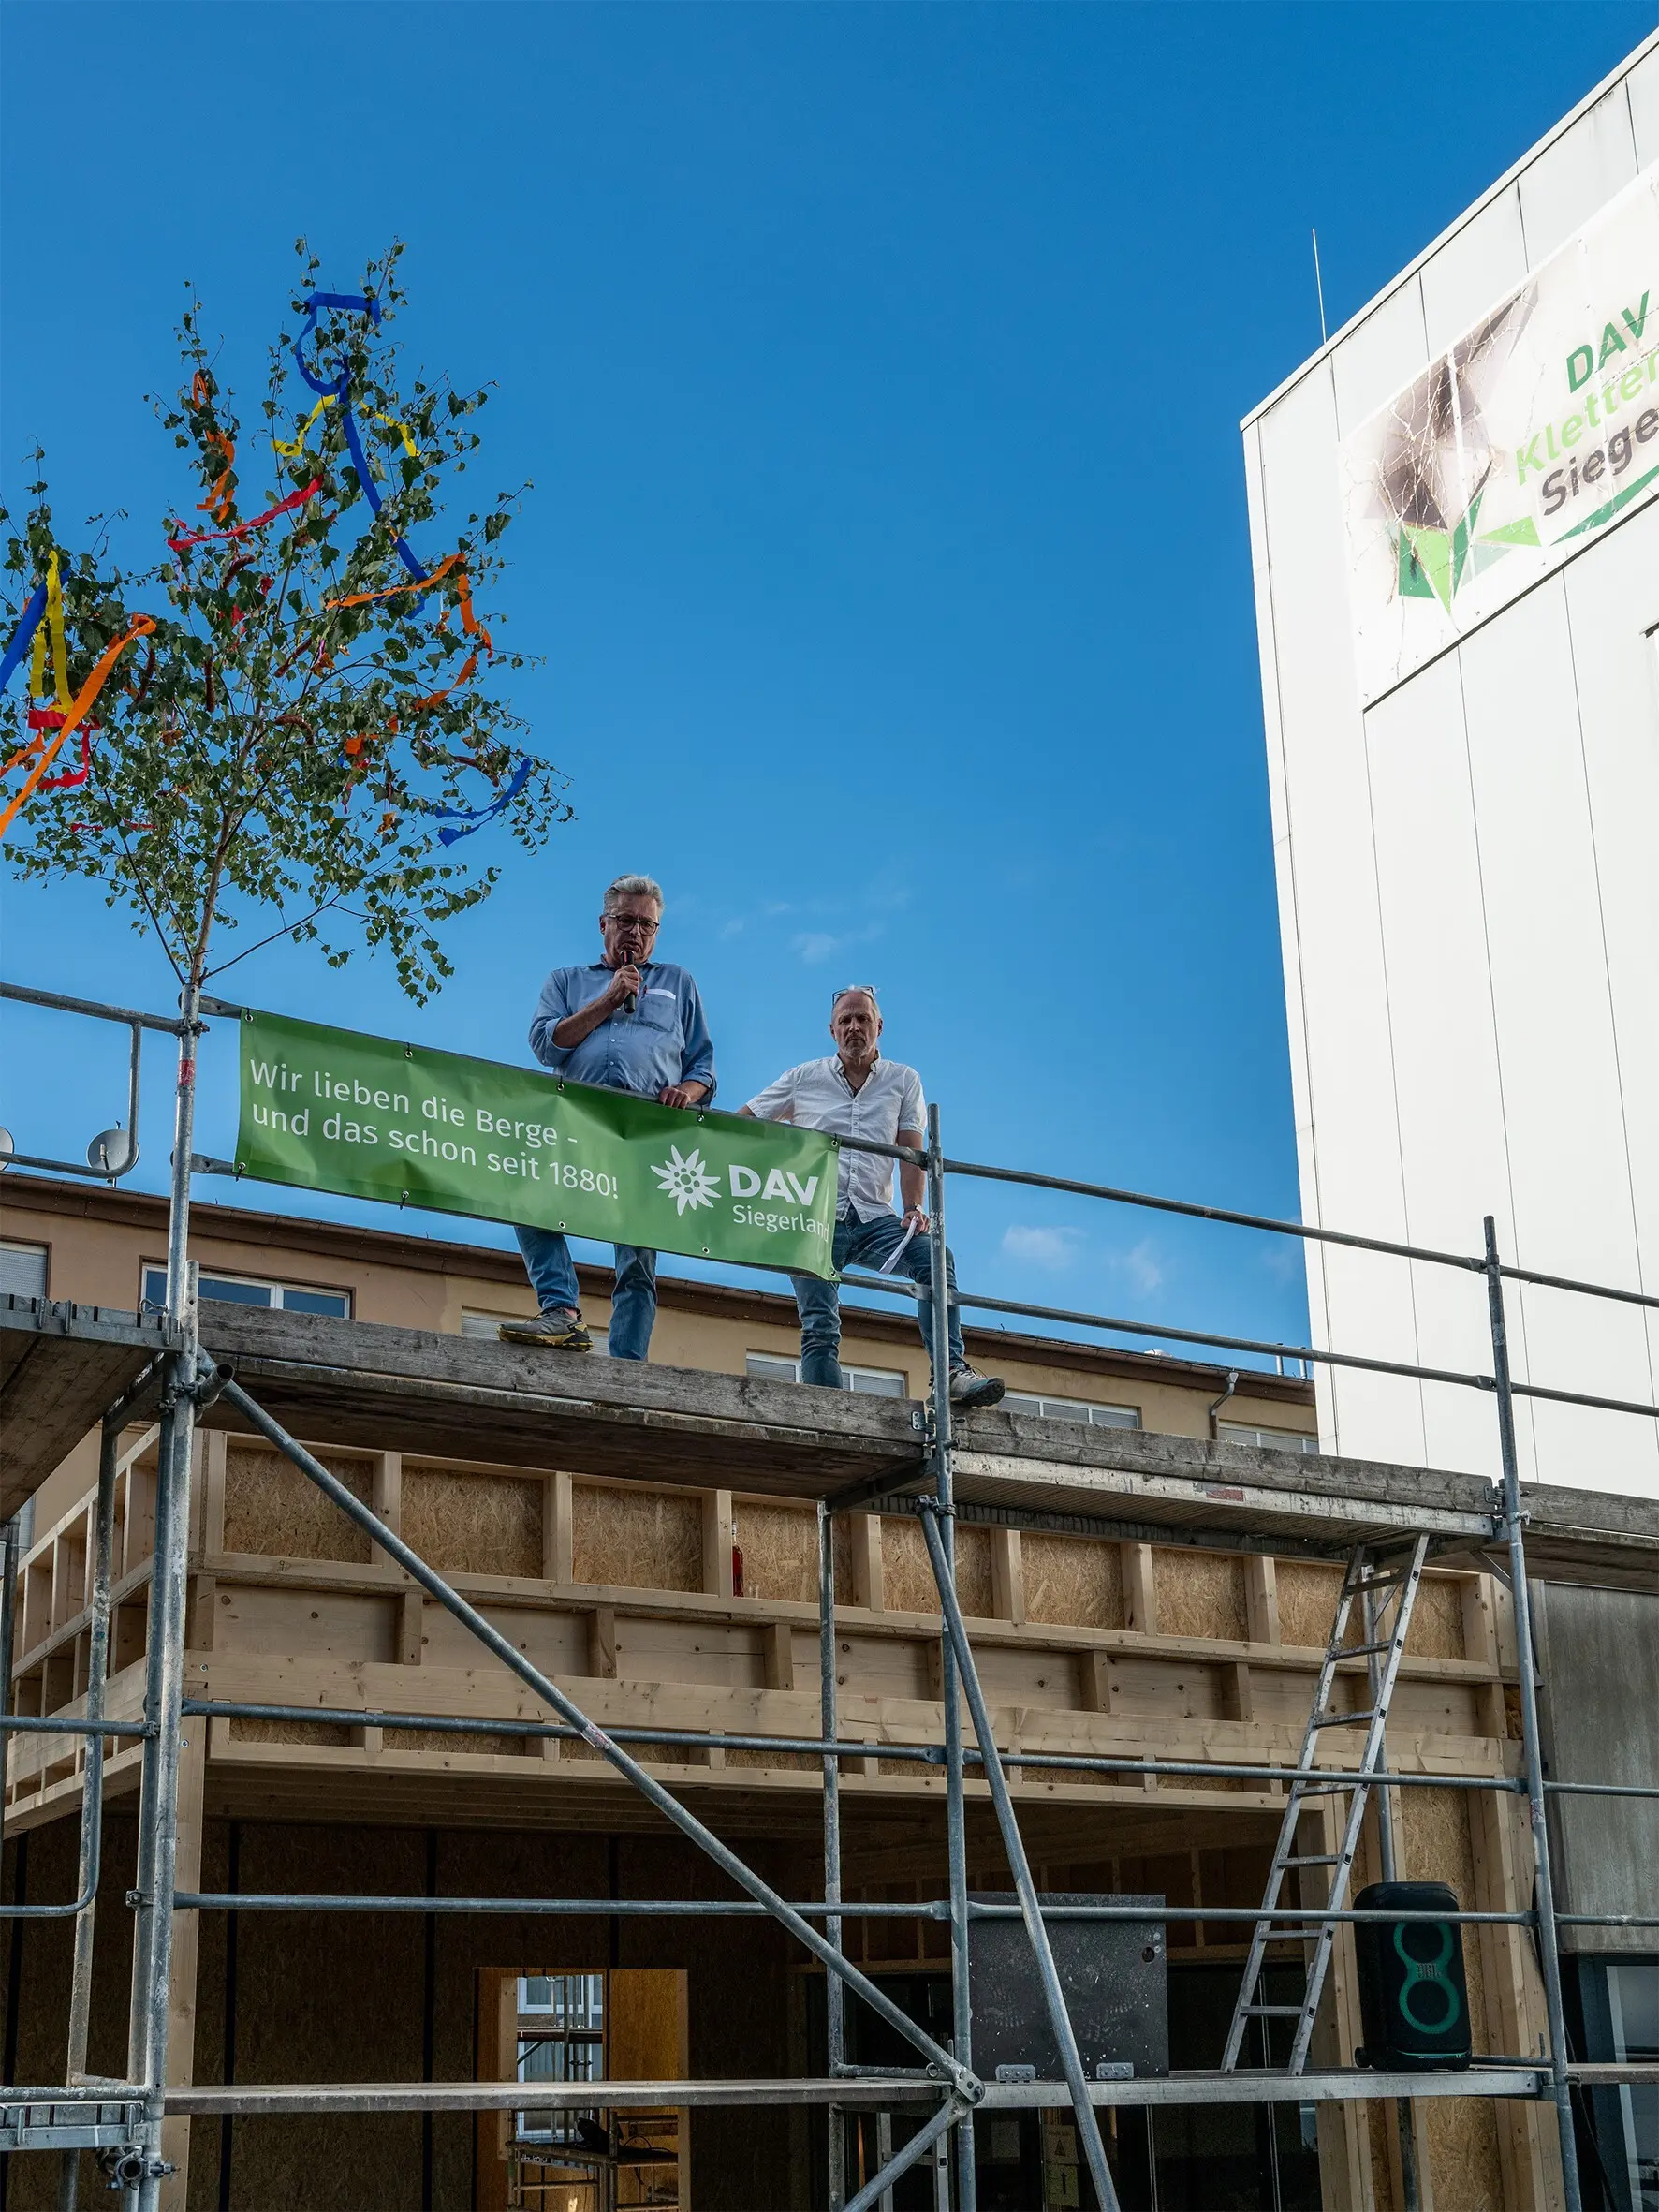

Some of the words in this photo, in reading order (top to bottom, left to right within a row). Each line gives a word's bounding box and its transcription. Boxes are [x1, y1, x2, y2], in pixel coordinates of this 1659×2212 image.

[1566, 289, 1650, 394] DAV
[1542, 407, 1659, 516] Siege
[250, 1059, 303, 1092] Wir
[315, 1071, 410, 1113] lieben
[421, 1096, 465, 1127] die
[477, 1109, 558, 1149] Berge
[253, 1103, 310, 1137] und
[322, 1113, 379, 1144] das
[389, 1128, 477, 1166] schon
[487, 1152, 540, 1180] seit
[549, 1161, 619, 1200] 1880!
[728, 1164, 819, 1206] DAV
[732, 1204, 830, 1243] Siegerland
